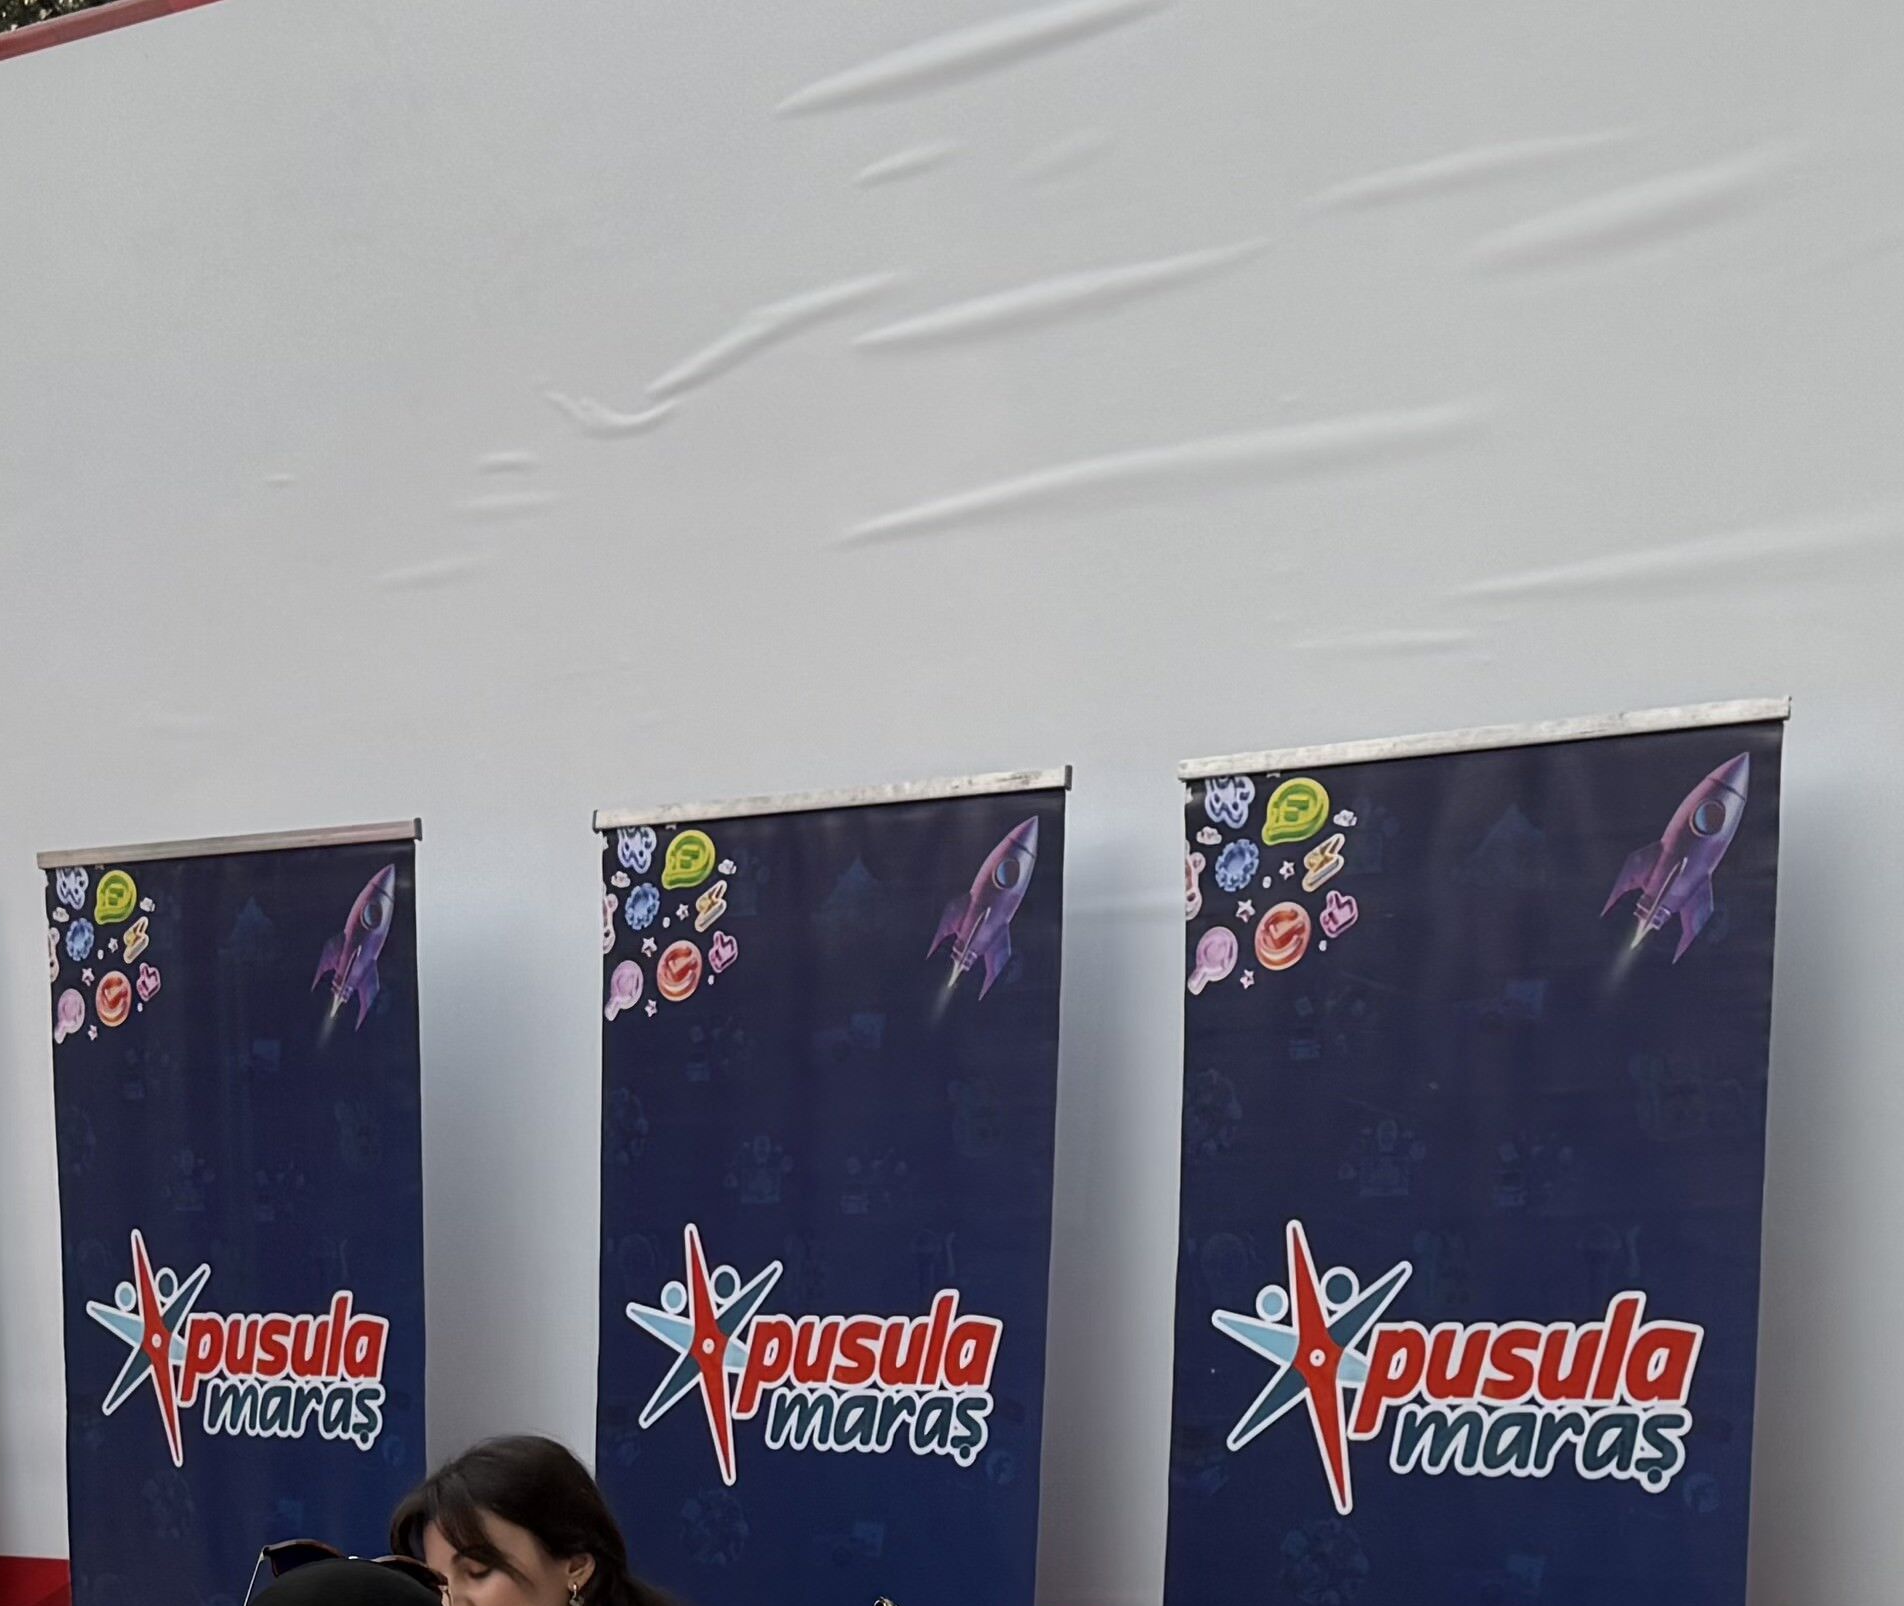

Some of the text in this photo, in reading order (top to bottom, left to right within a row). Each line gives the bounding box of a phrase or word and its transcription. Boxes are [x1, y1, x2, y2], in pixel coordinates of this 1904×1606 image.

[180, 1291, 390, 1408] pusula
[733, 1289, 1003, 1417] pusula
[1349, 1291, 1704, 1440] pusula
[203, 1379, 386, 1452] maraş
[765, 1386, 994, 1466] maraş
[1388, 1400, 1693, 1493] maraş
